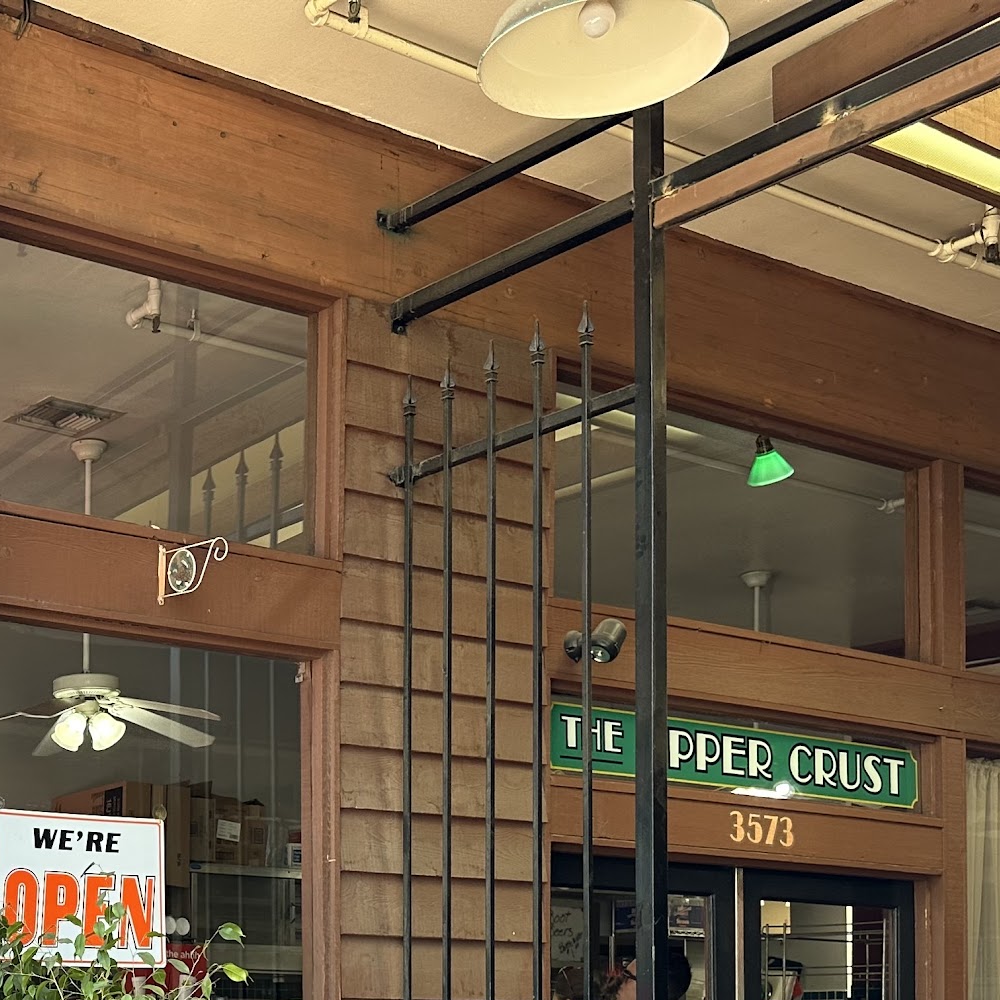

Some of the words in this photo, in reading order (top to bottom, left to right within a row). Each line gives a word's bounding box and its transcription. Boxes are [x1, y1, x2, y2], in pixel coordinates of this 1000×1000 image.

[560, 714, 625, 754] THE
[667, 727, 774, 780] PPER
[788, 744, 906, 796] CRUST
[33, 827, 122, 854] WE'RE
[729, 810, 794, 847] 3573
[2, 867, 156, 952] OPEN
